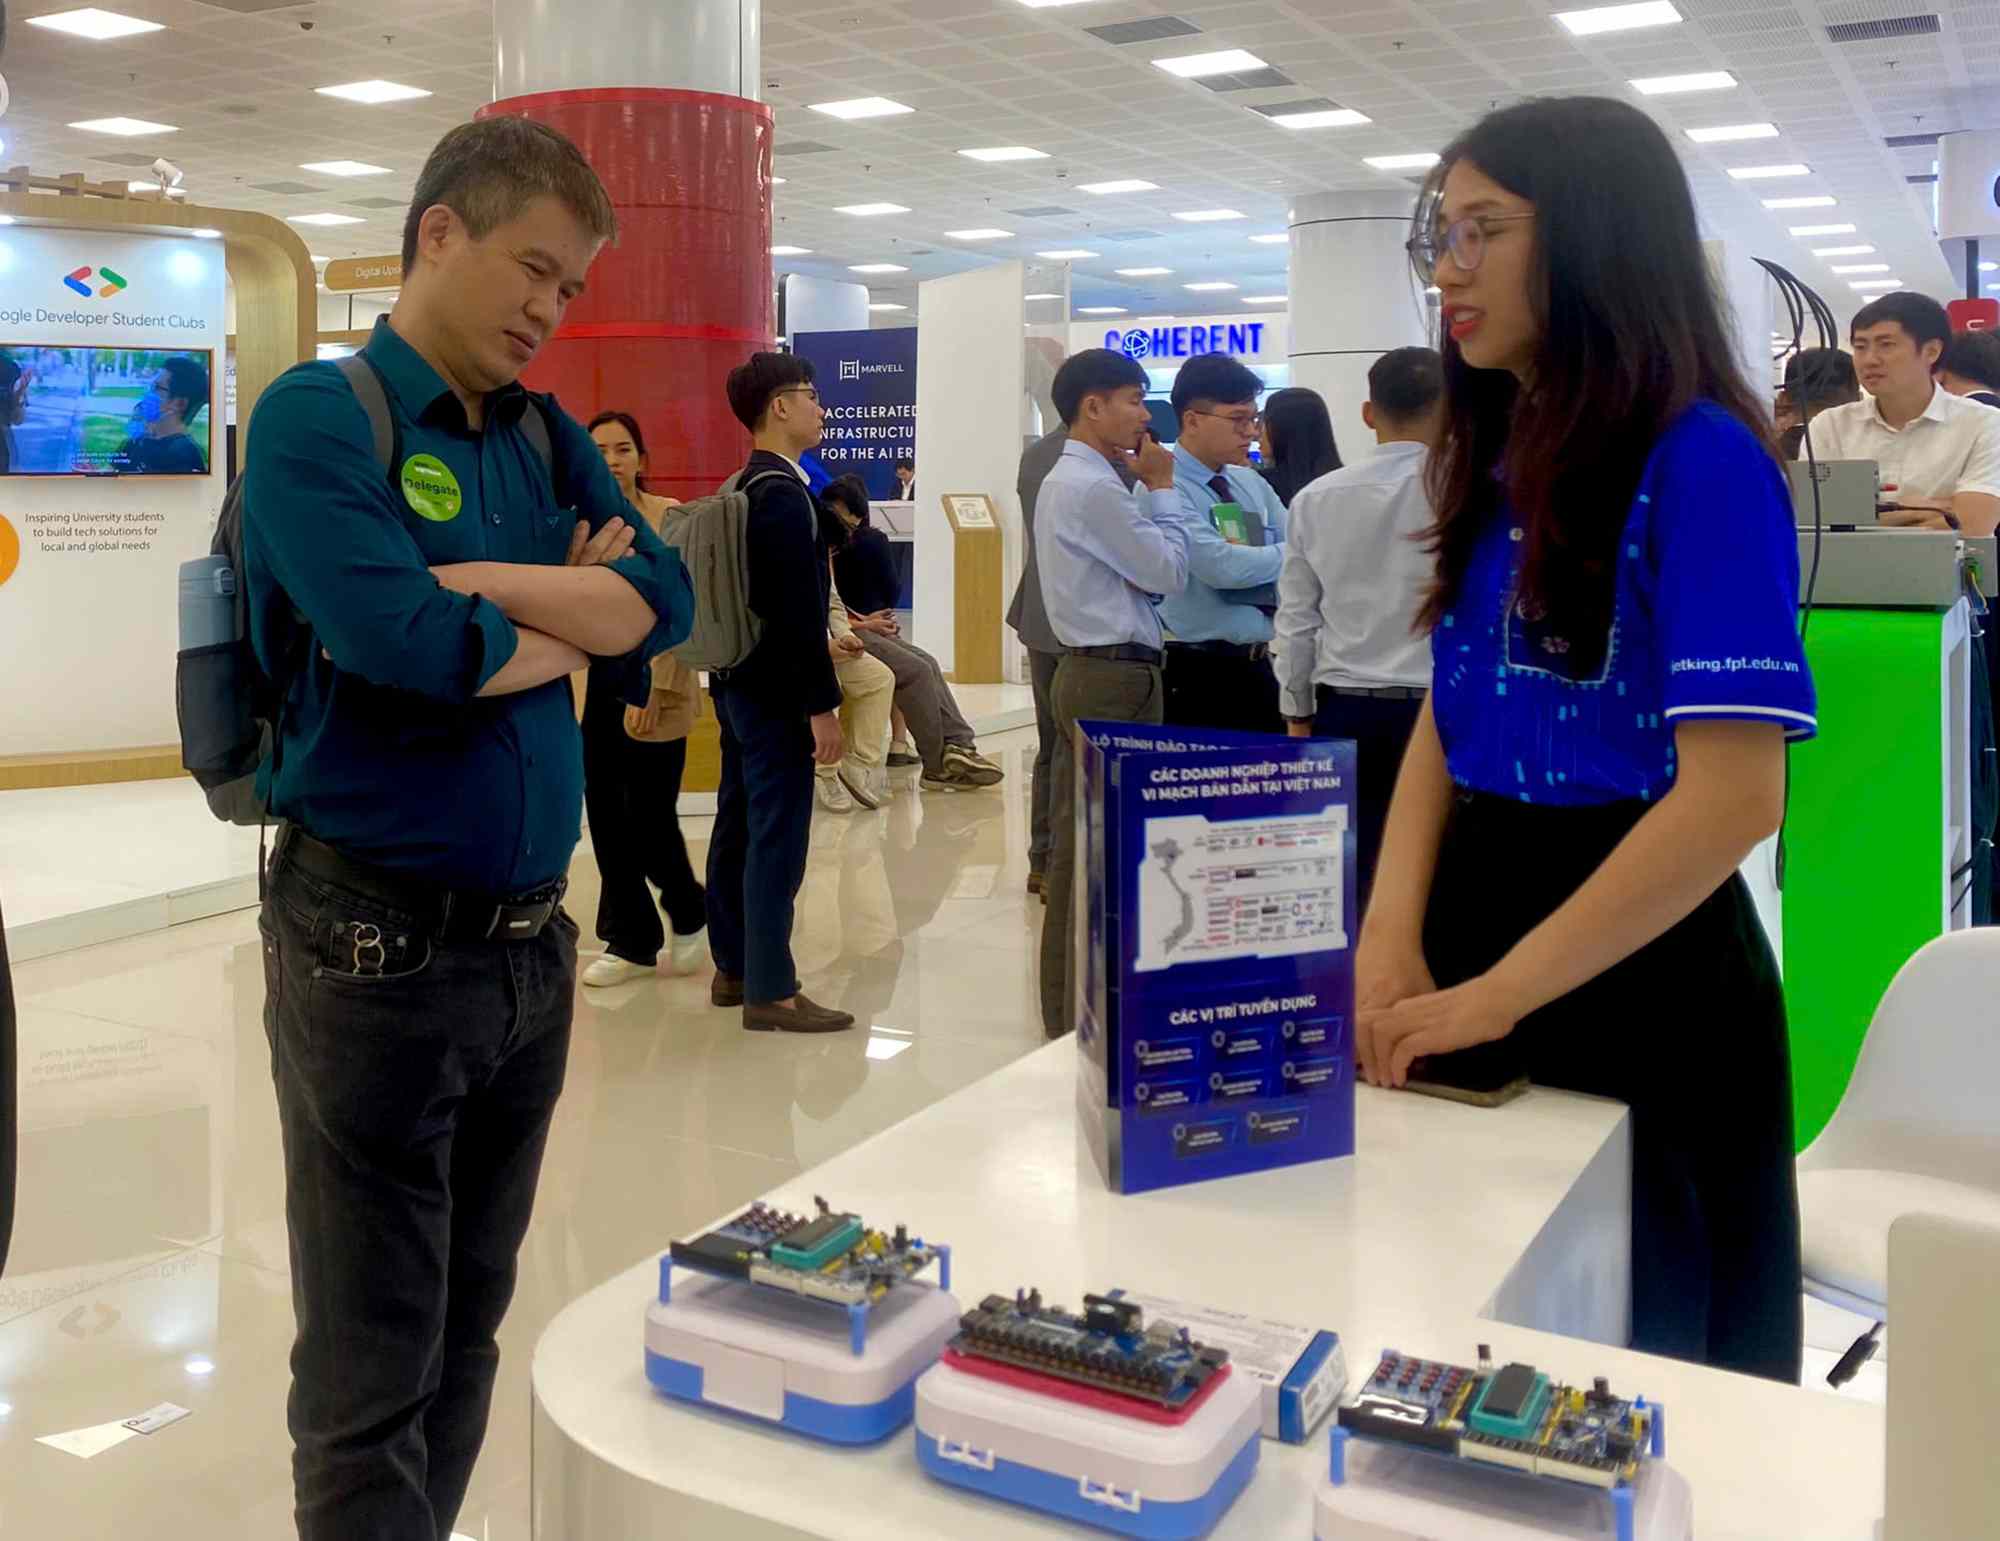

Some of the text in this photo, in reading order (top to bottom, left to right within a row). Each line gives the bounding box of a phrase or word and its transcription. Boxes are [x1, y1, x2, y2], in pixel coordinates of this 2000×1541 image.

[0, 308, 206, 329] ogle Developer Student Clubs
[861, 363, 904, 374] MARVELL
[820, 426, 914, 439] NFRASTRUCTU
[821, 447, 913, 460] FOR THE AI ER
[25, 512, 165, 524] Inspiring University students
[33, 526, 157, 537] to build tech solutions for
[41, 541, 151, 553] local and global needs
[1150, 767, 1179, 782] CÁC
[1181, 766, 1229, 780] DOANH
[1231, 760, 1279, 778] NGHIỆP
[1142, 787, 1156, 801] VI
[1158, 785, 1198, 802] MẠCH
[1262, 781, 1281, 796] TẠI
[1283, 777, 1310, 793] VIỆT
[1311, 777, 1341, 789] NAM
[1169, 1008, 1198, 1025] CÁC
[1200, 1008, 1214, 1023] VỊ
[1216, 1002, 1238, 1020] TRÍ
[1281, 995, 1317, 1013] DỤNG
